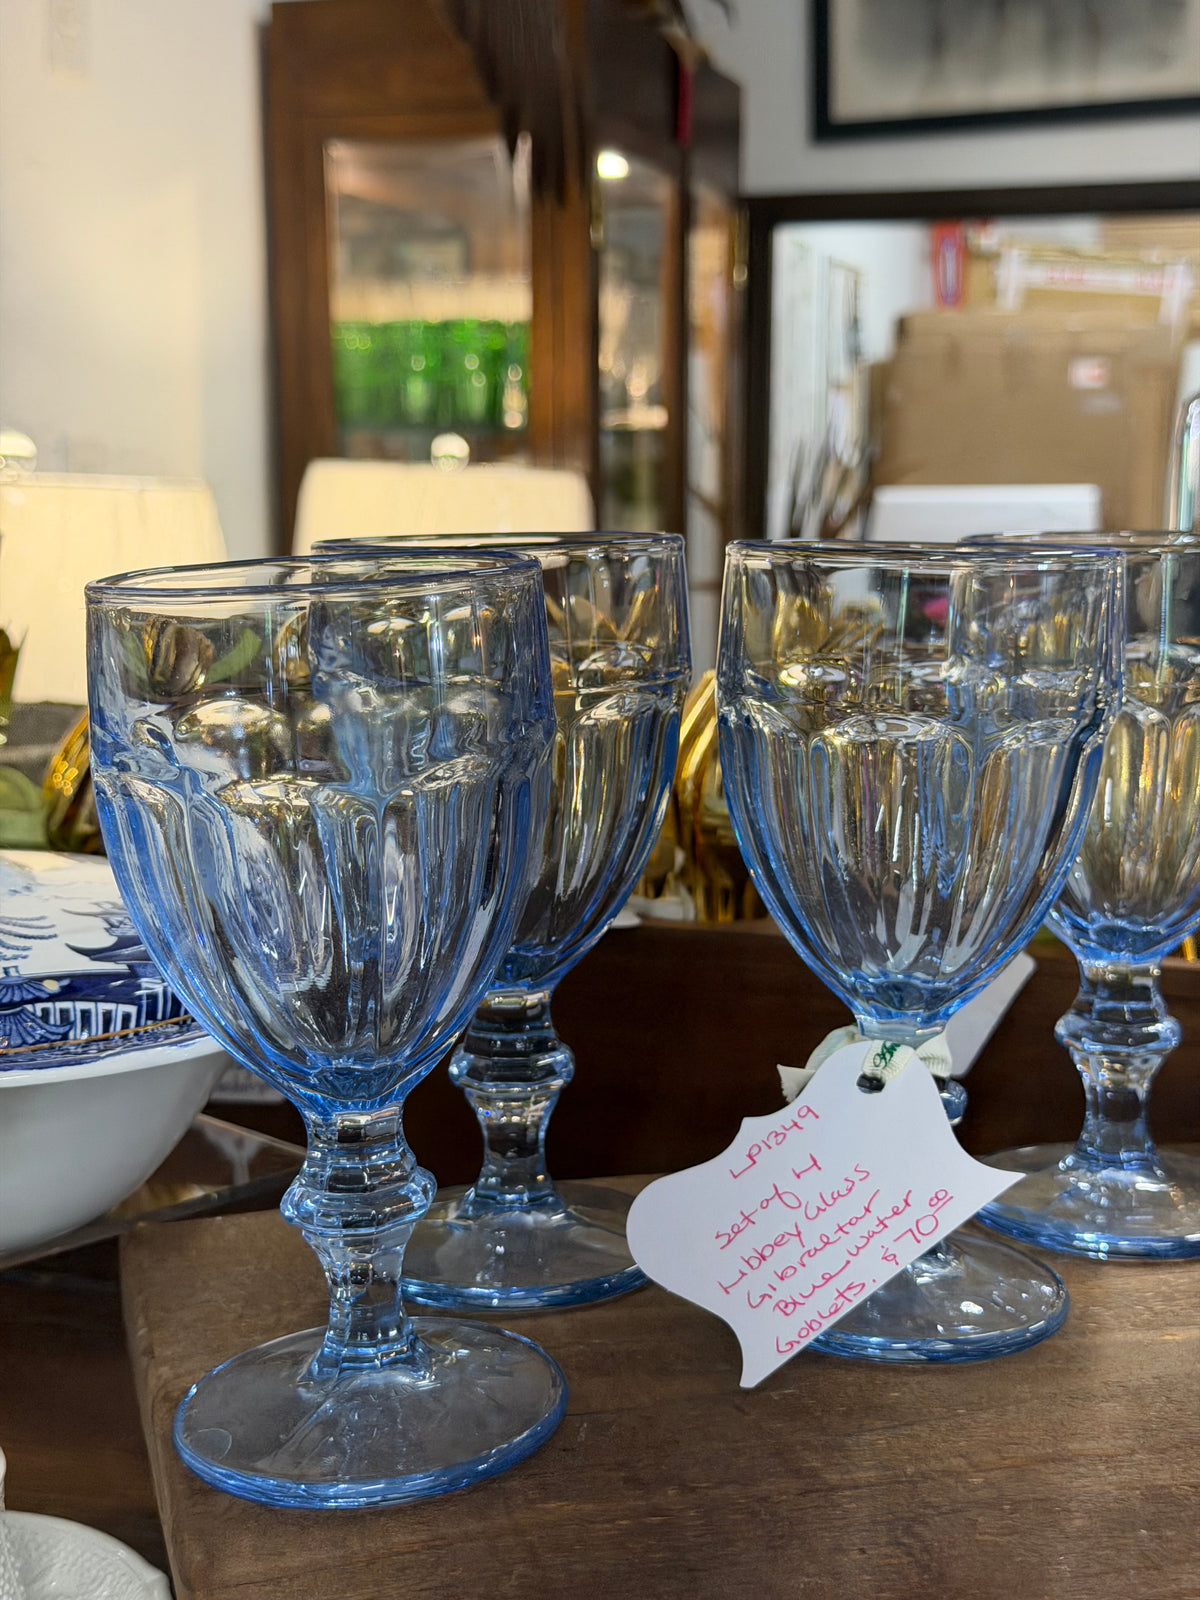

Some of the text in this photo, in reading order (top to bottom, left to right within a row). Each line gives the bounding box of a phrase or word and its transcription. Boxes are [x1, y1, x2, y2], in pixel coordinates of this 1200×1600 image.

[729, 1104, 820, 1180] LP1349
[759, 1182, 803, 1211] of
[791, 1152, 822, 1180] 4
[803, 1162, 871, 1222] Glass
[746, 1188, 881, 1310] Gibraltar
[772, 1258, 851, 1317] Blue
